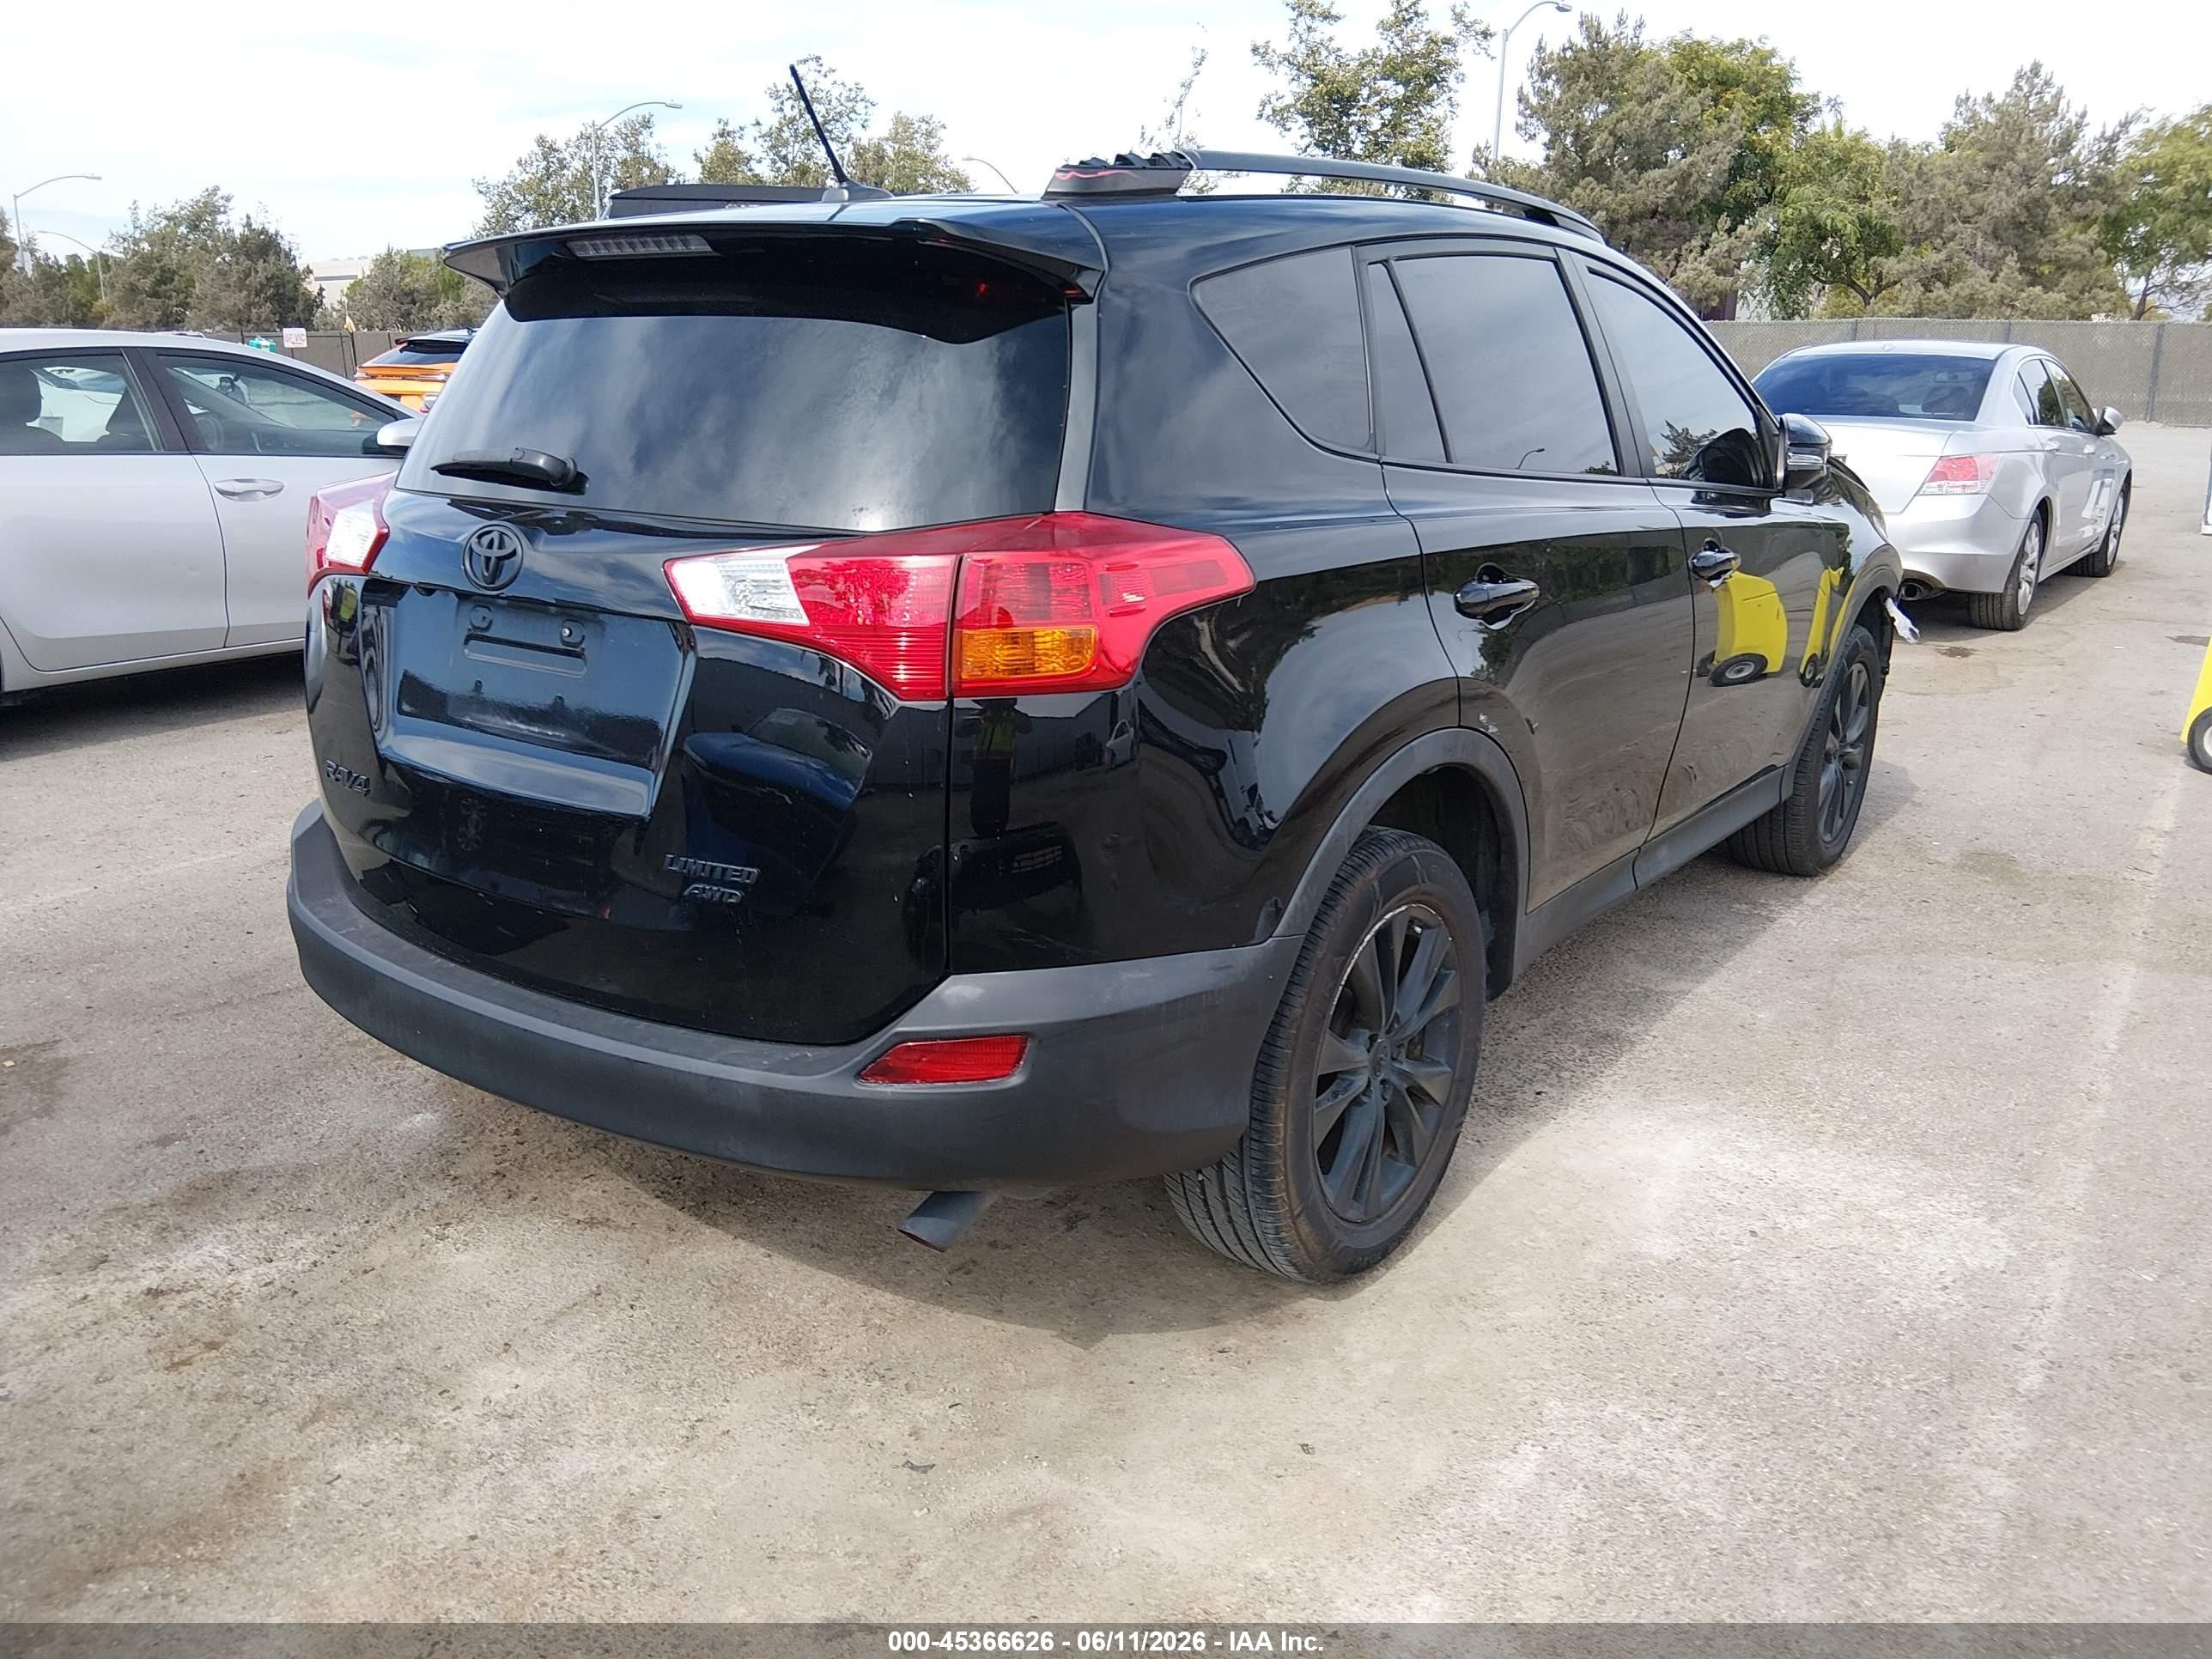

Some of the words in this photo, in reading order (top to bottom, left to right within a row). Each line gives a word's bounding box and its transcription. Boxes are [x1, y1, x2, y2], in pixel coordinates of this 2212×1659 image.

[325, 759, 370, 796] RAV4
[664, 854, 758, 884] LIMITED
[684, 884, 743, 902] AWD
